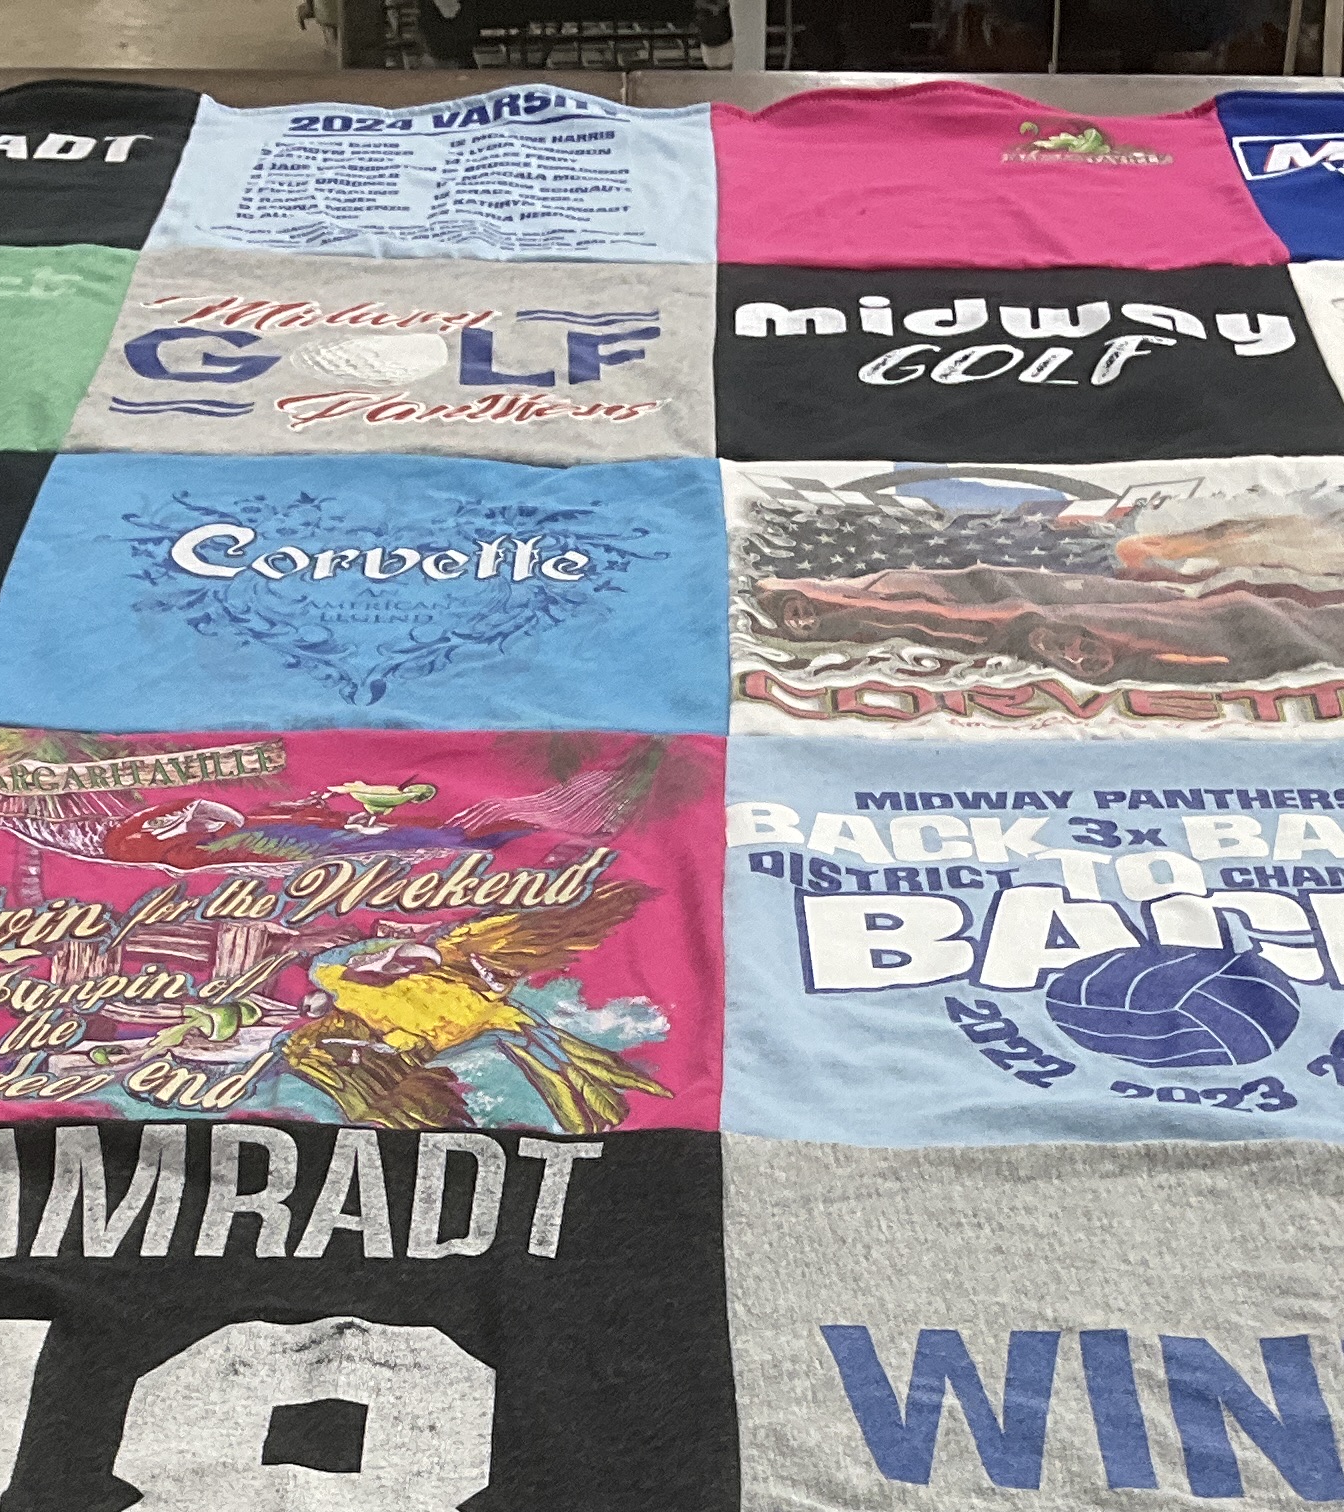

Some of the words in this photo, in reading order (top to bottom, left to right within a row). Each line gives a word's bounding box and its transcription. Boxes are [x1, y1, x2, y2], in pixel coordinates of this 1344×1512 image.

[289, 115, 413, 133] 2024
[734, 295, 1297, 357] midway
[858, 334, 1178, 386] GOLF
[169, 521, 591, 583] Corvette
[855, 788, 1074, 811] MIDWAY
[725, 801, 1051, 864] BACK
[1067, 816, 1168, 849] 3x
[118, 892, 203, 944] for
[212, 876, 280, 921] the
[288, 846, 614, 922] Weekend
[748, 849, 1020, 893] DISTRICT
[1035, 847, 1208, 902] TO
[0, 1013, 80, 1054] the
[943, 995, 1077, 1091] 2022
[1108, 1075, 1299, 1114] 2023
[125, 1052, 270, 1111] end
